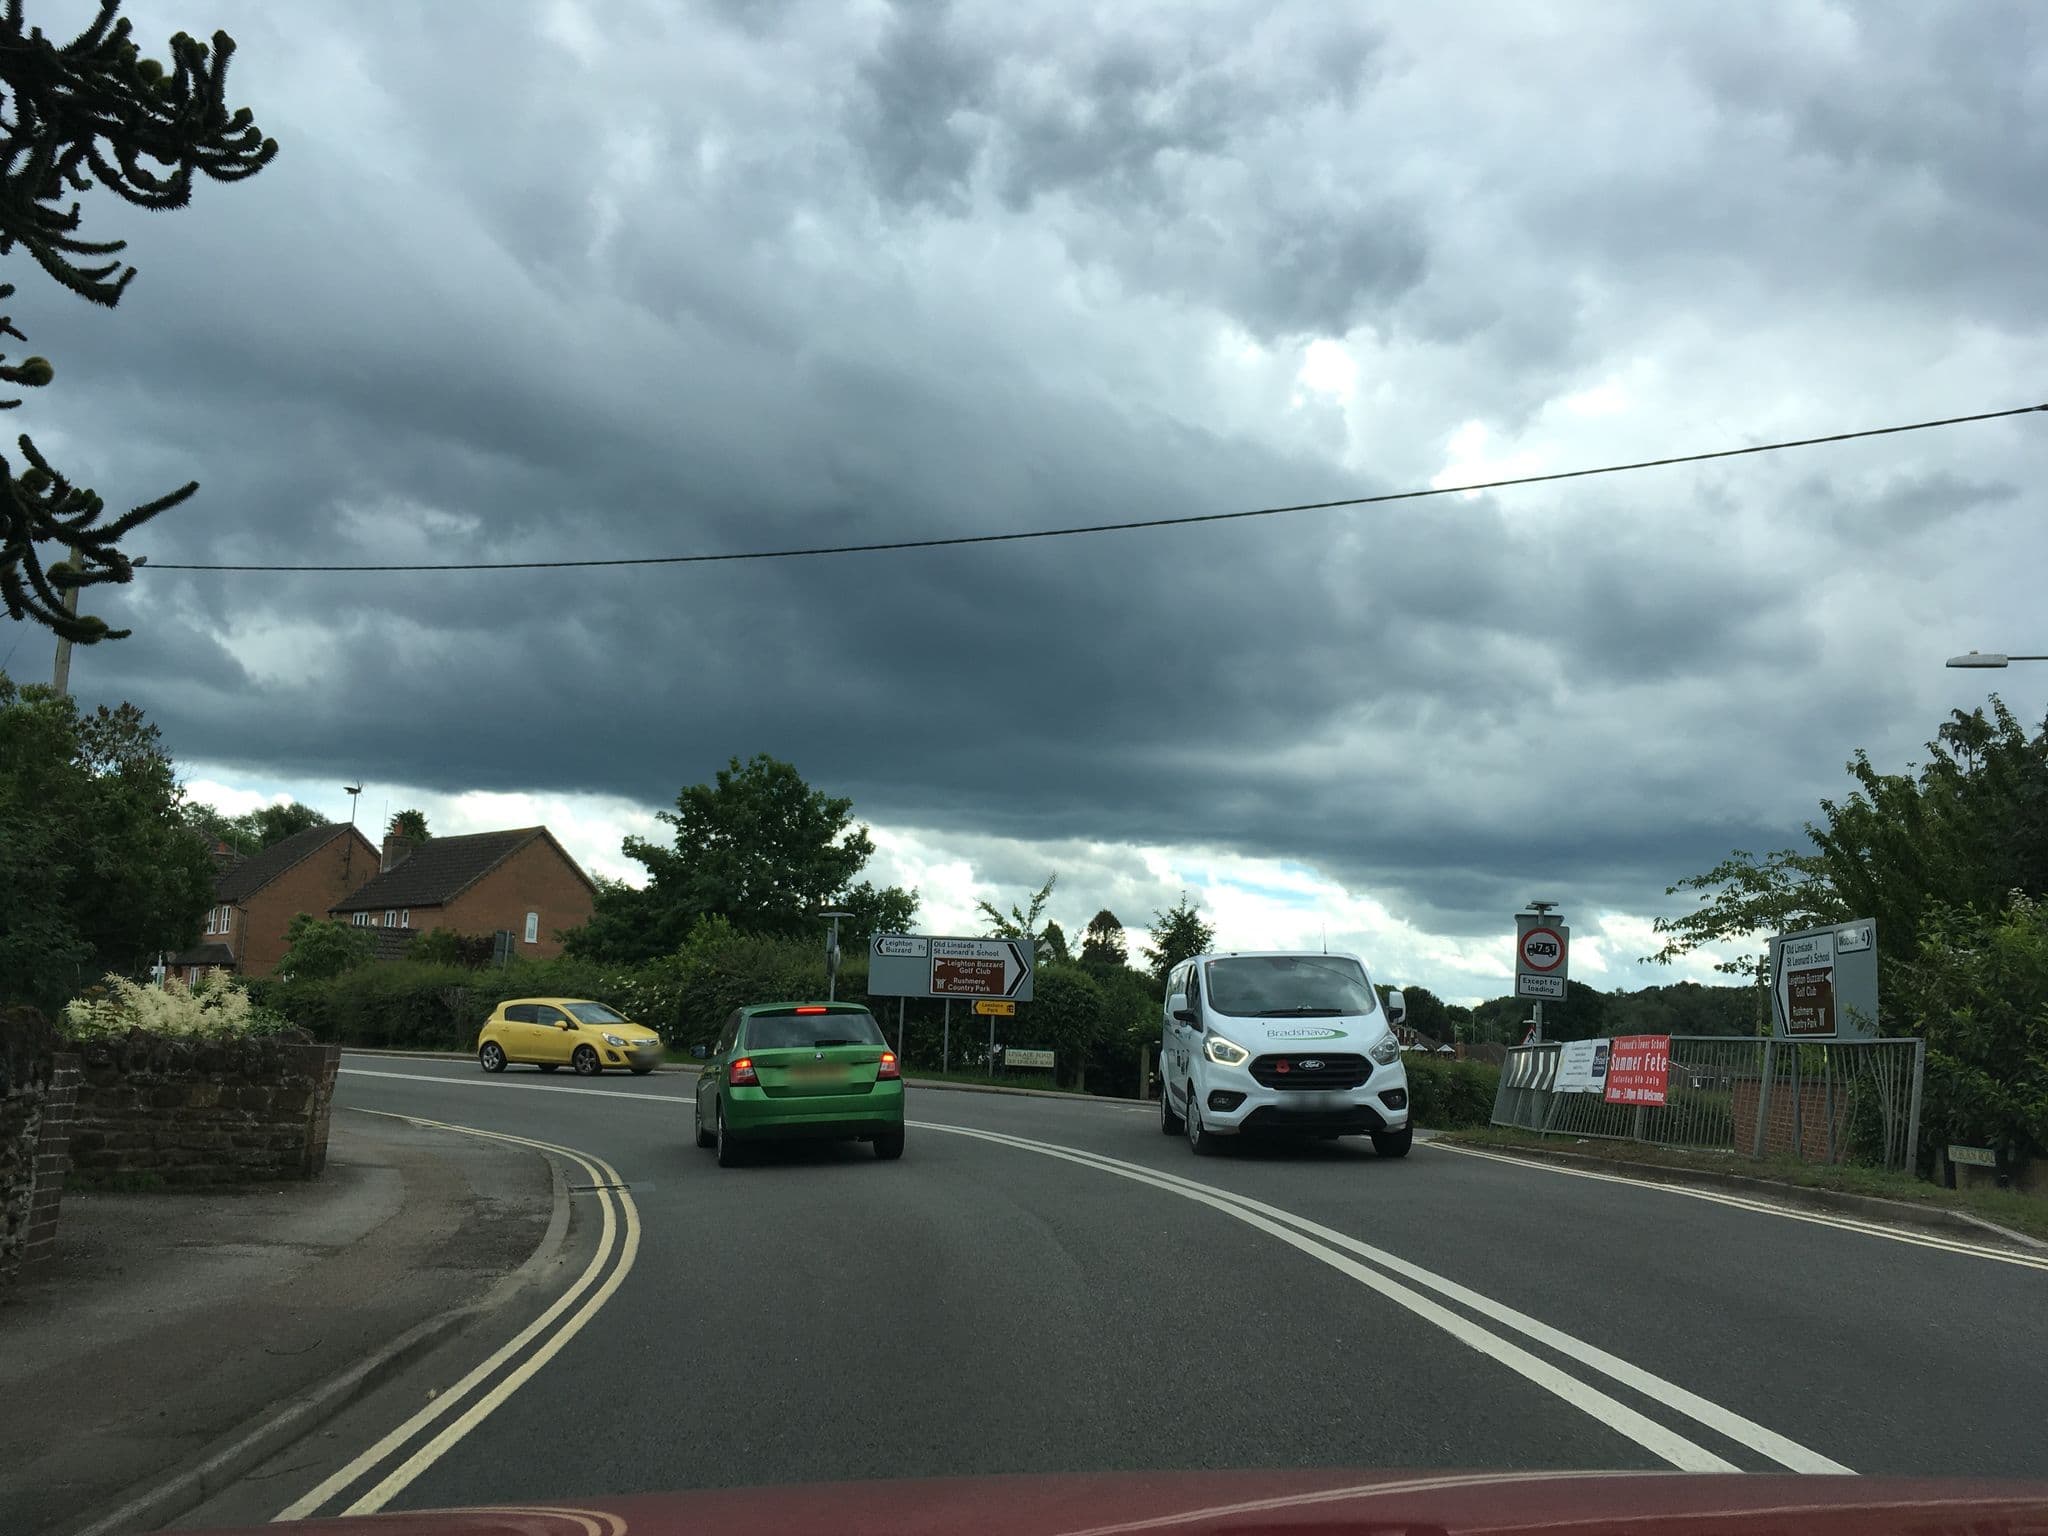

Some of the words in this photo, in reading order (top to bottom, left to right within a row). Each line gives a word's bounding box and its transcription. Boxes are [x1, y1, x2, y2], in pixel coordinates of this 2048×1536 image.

[885, 940, 913, 948] Leighton
[933, 941, 946, 949] Old
[947, 941, 975, 949] Linslade
[1786, 945, 1794, 955] Old
[1794, 942, 1813, 953] Linslade
[942, 948, 975, 956] Leonard's
[976, 949, 999, 957] School
[1814, 952, 1830, 963] School
[947, 959, 976, 968] Leighton
[976, 961, 1004, 969] Buzzard
[953, 977, 986, 985] Rushmere
[1522, 977, 1548, 986] Except
[1806, 972, 1825, 983] Buzzard
[947, 983, 974, 992] Country
[975, 985, 991, 993] Park
[1528, 985, 1555, 994] loading
[1796, 986, 1806, 997] Golf
[1806, 986, 1817, 996] Club
[1790, 1019, 1807, 1030] Country
[1807, 1018, 1817, 1028] Park
[1267, 1029, 1330, 1037] Bradshaw
[1651, 1039, 1667, 1050] School
[1611, 1053, 1641, 1071] Summer
[1644, 1052, 1667, 1072] Fete
[1613, 1075, 1632, 1084] Saturday
[1645, 1075, 1659, 1086] July
[1644, 1089, 1664, 1101] Welcome
